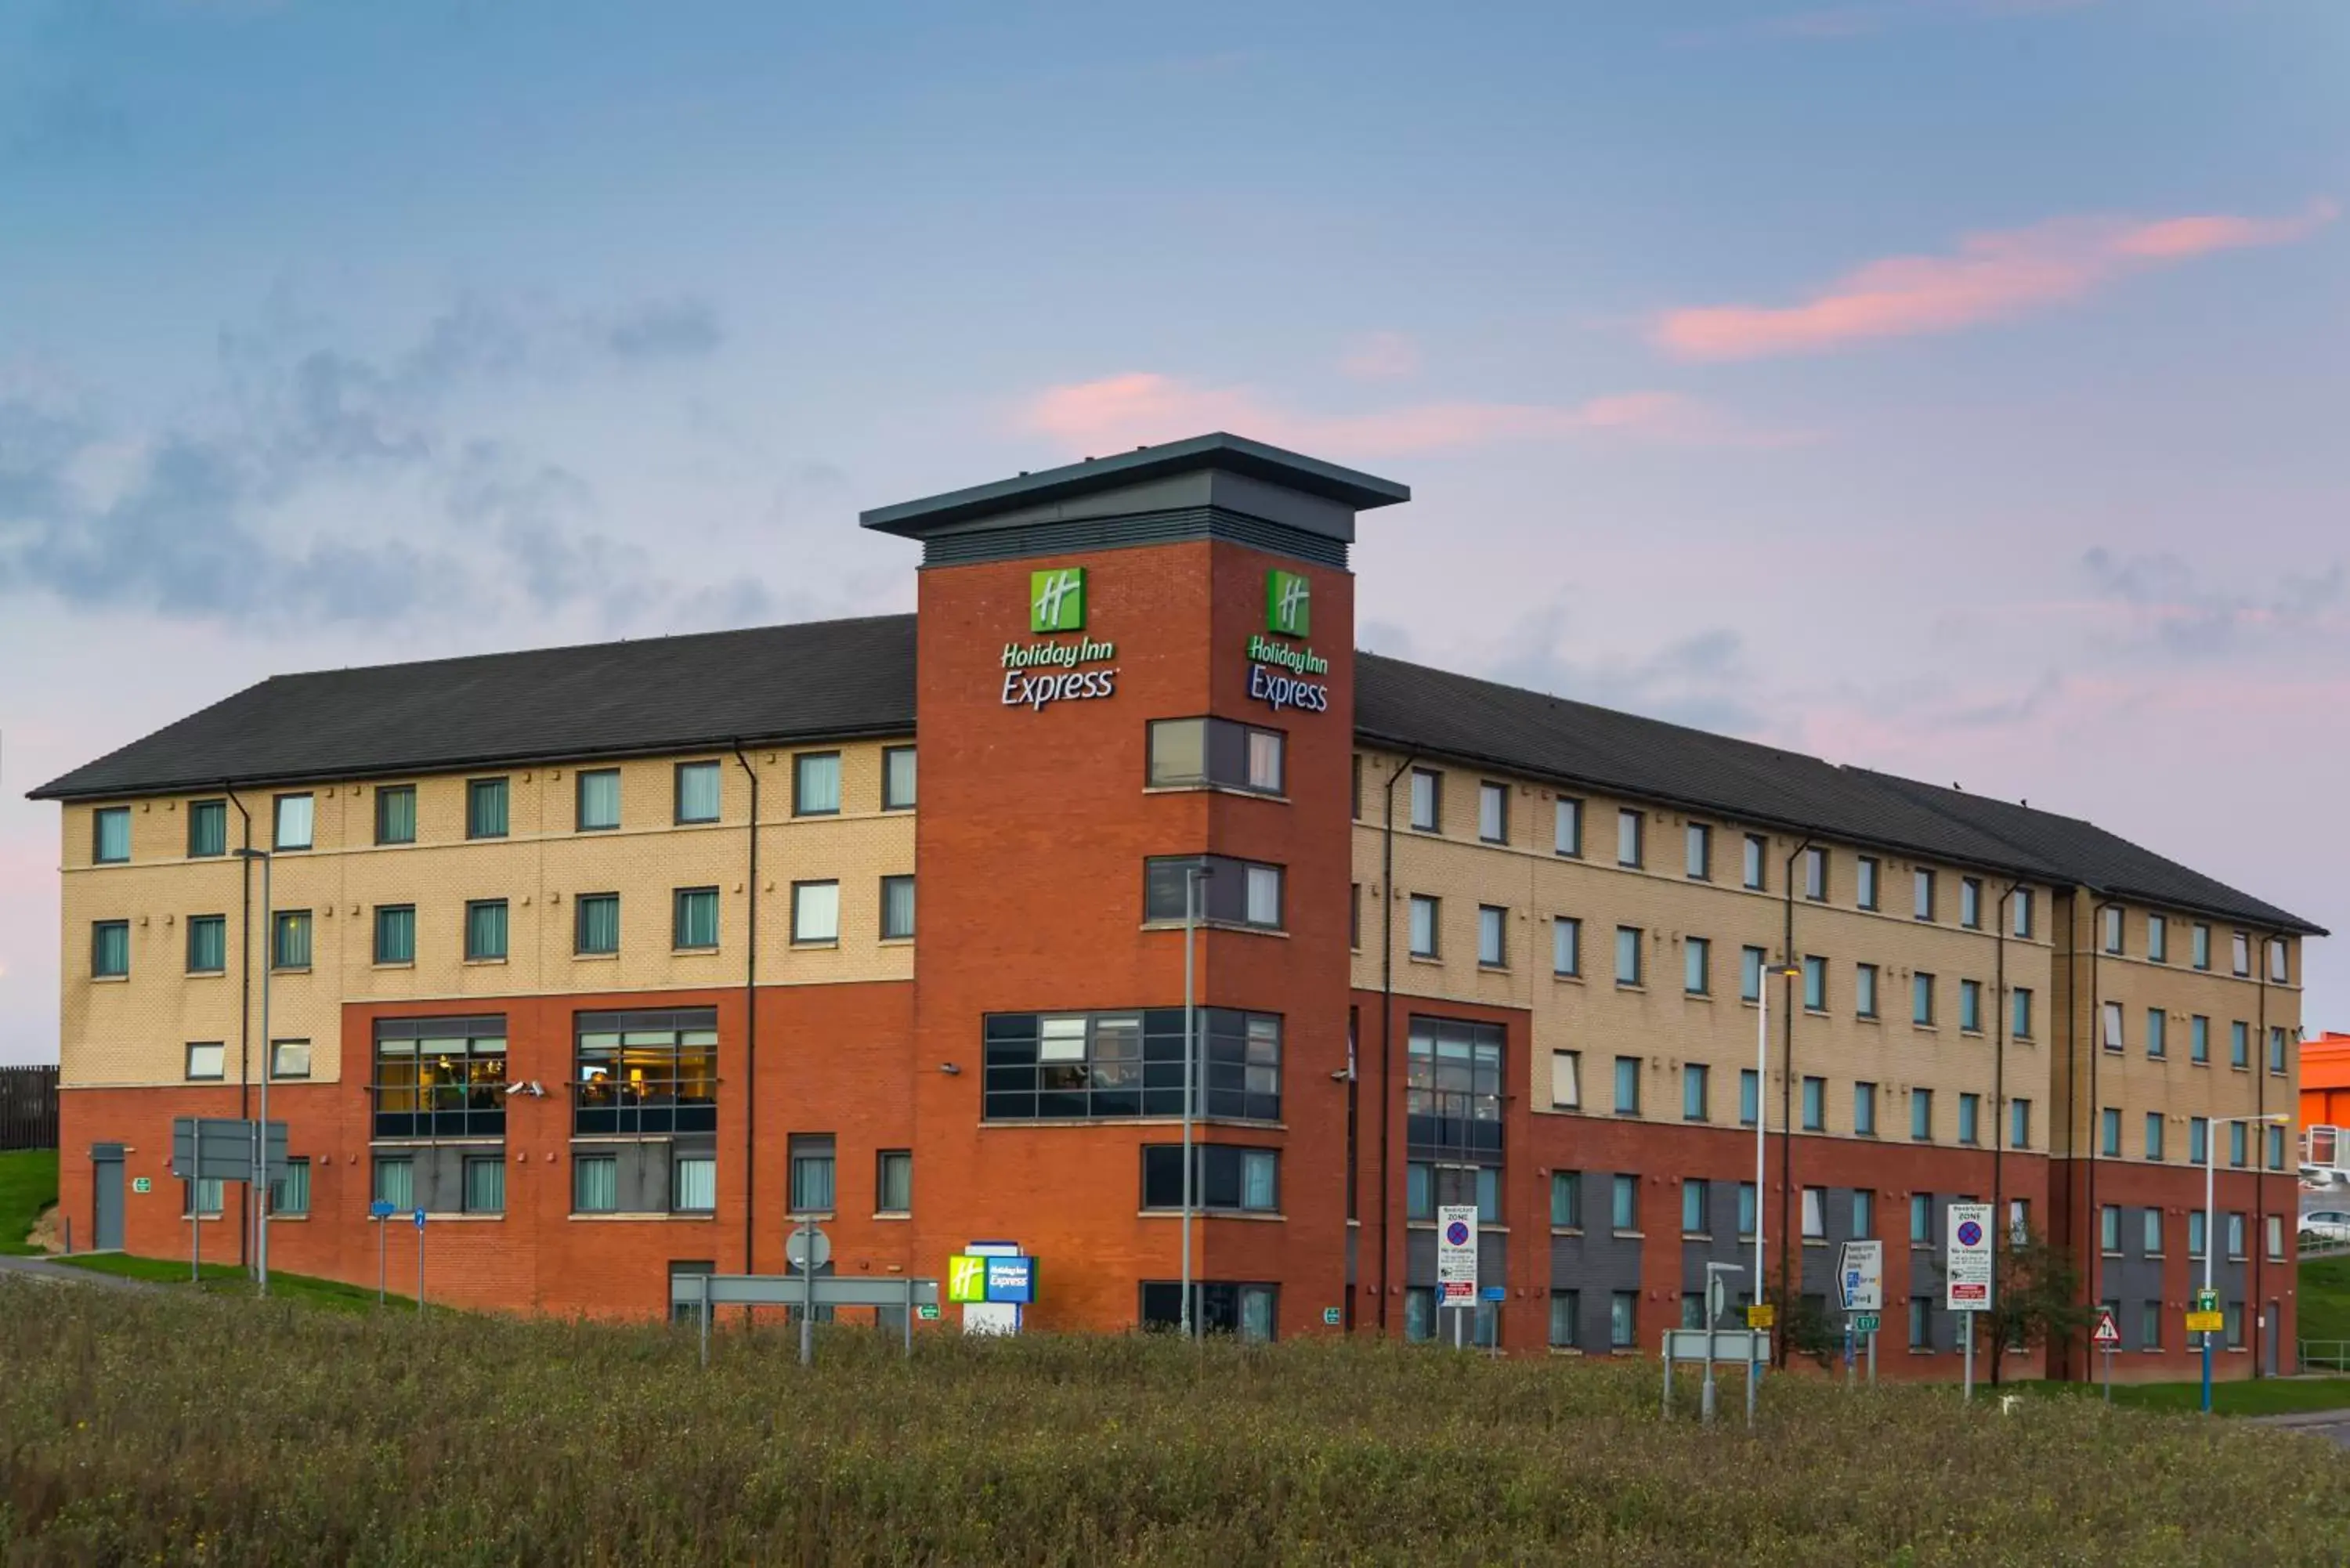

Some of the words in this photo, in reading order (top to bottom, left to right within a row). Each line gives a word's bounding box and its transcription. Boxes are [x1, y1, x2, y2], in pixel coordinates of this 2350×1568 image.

[1003, 640, 1079, 668] Holiday
[1080, 636, 1113, 662] Inn
[1249, 635, 1304, 675] Holiday
[1306, 647, 1329, 675] Inn
[1002, 670, 1114, 711] Express
[1251, 663, 1329, 713] Express
[989, 1274, 1027, 1288] Express
